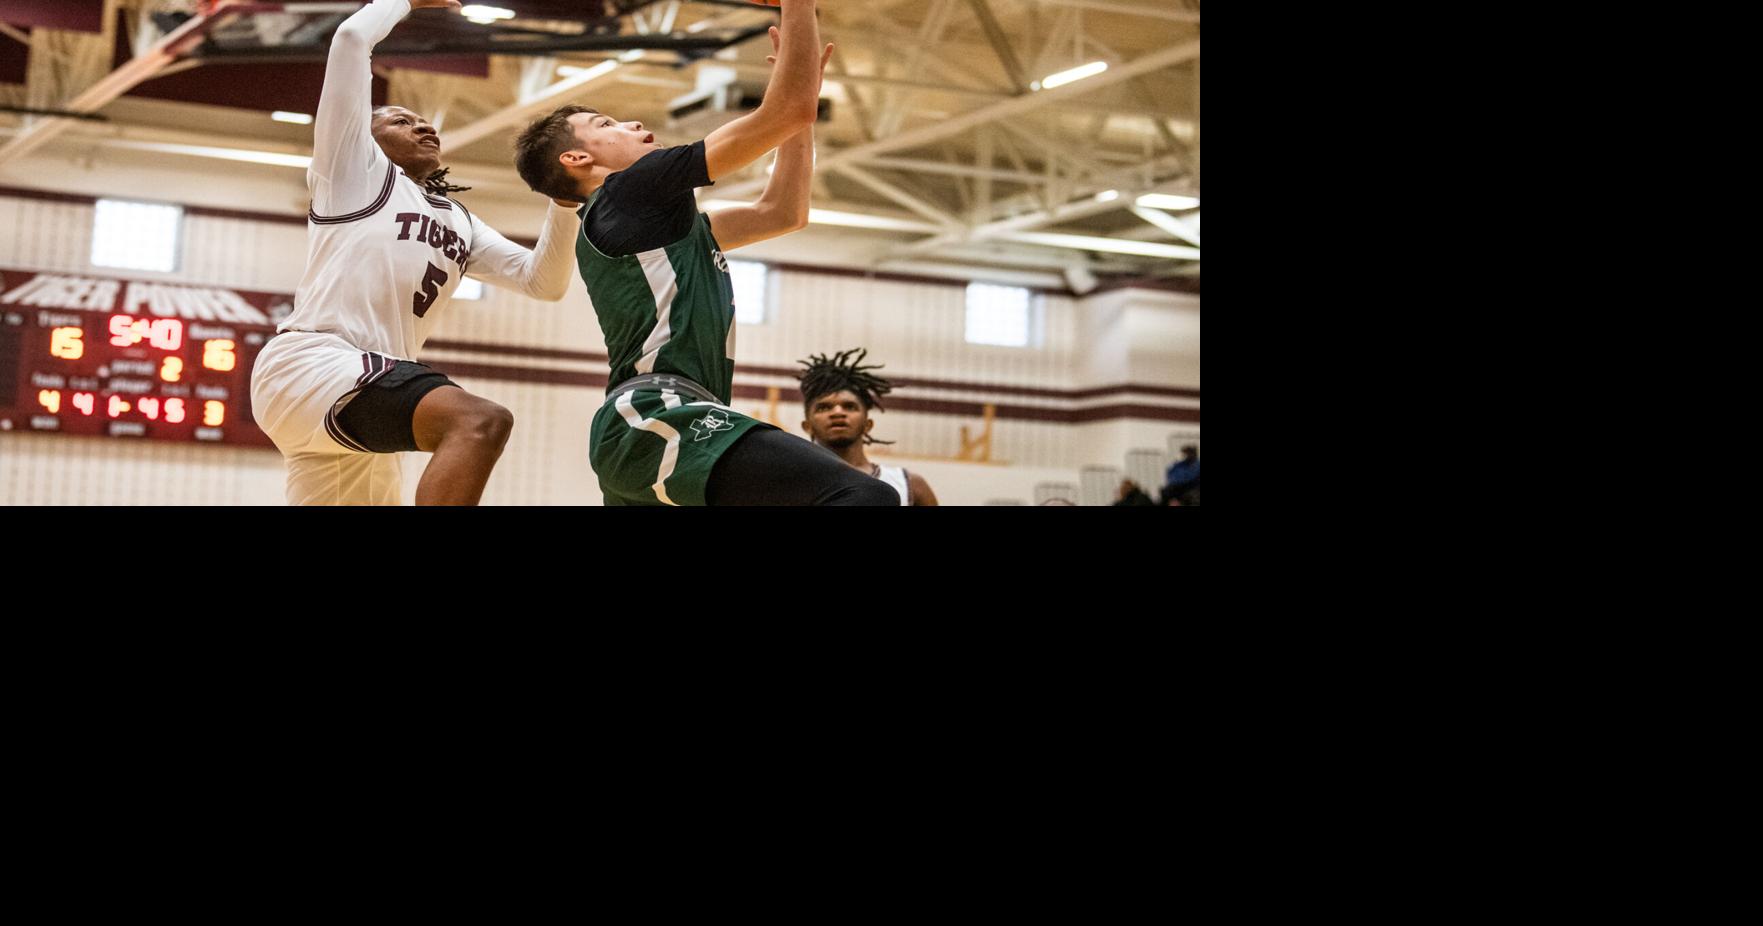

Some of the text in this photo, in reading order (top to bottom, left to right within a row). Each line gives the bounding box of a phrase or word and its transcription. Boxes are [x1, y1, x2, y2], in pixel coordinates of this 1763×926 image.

[395, 212, 470, 265] TIGER
[0, 274, 270, 325] TIGER POWER
[413, 261, 448, 318] 5
[51, 327, 83, 359] 15
[161, 357, 183, 381] 2
[39, 390, 60, 413] 4
[72, 392, 94, 415] 4
[204, 400, 224, 425] 3
